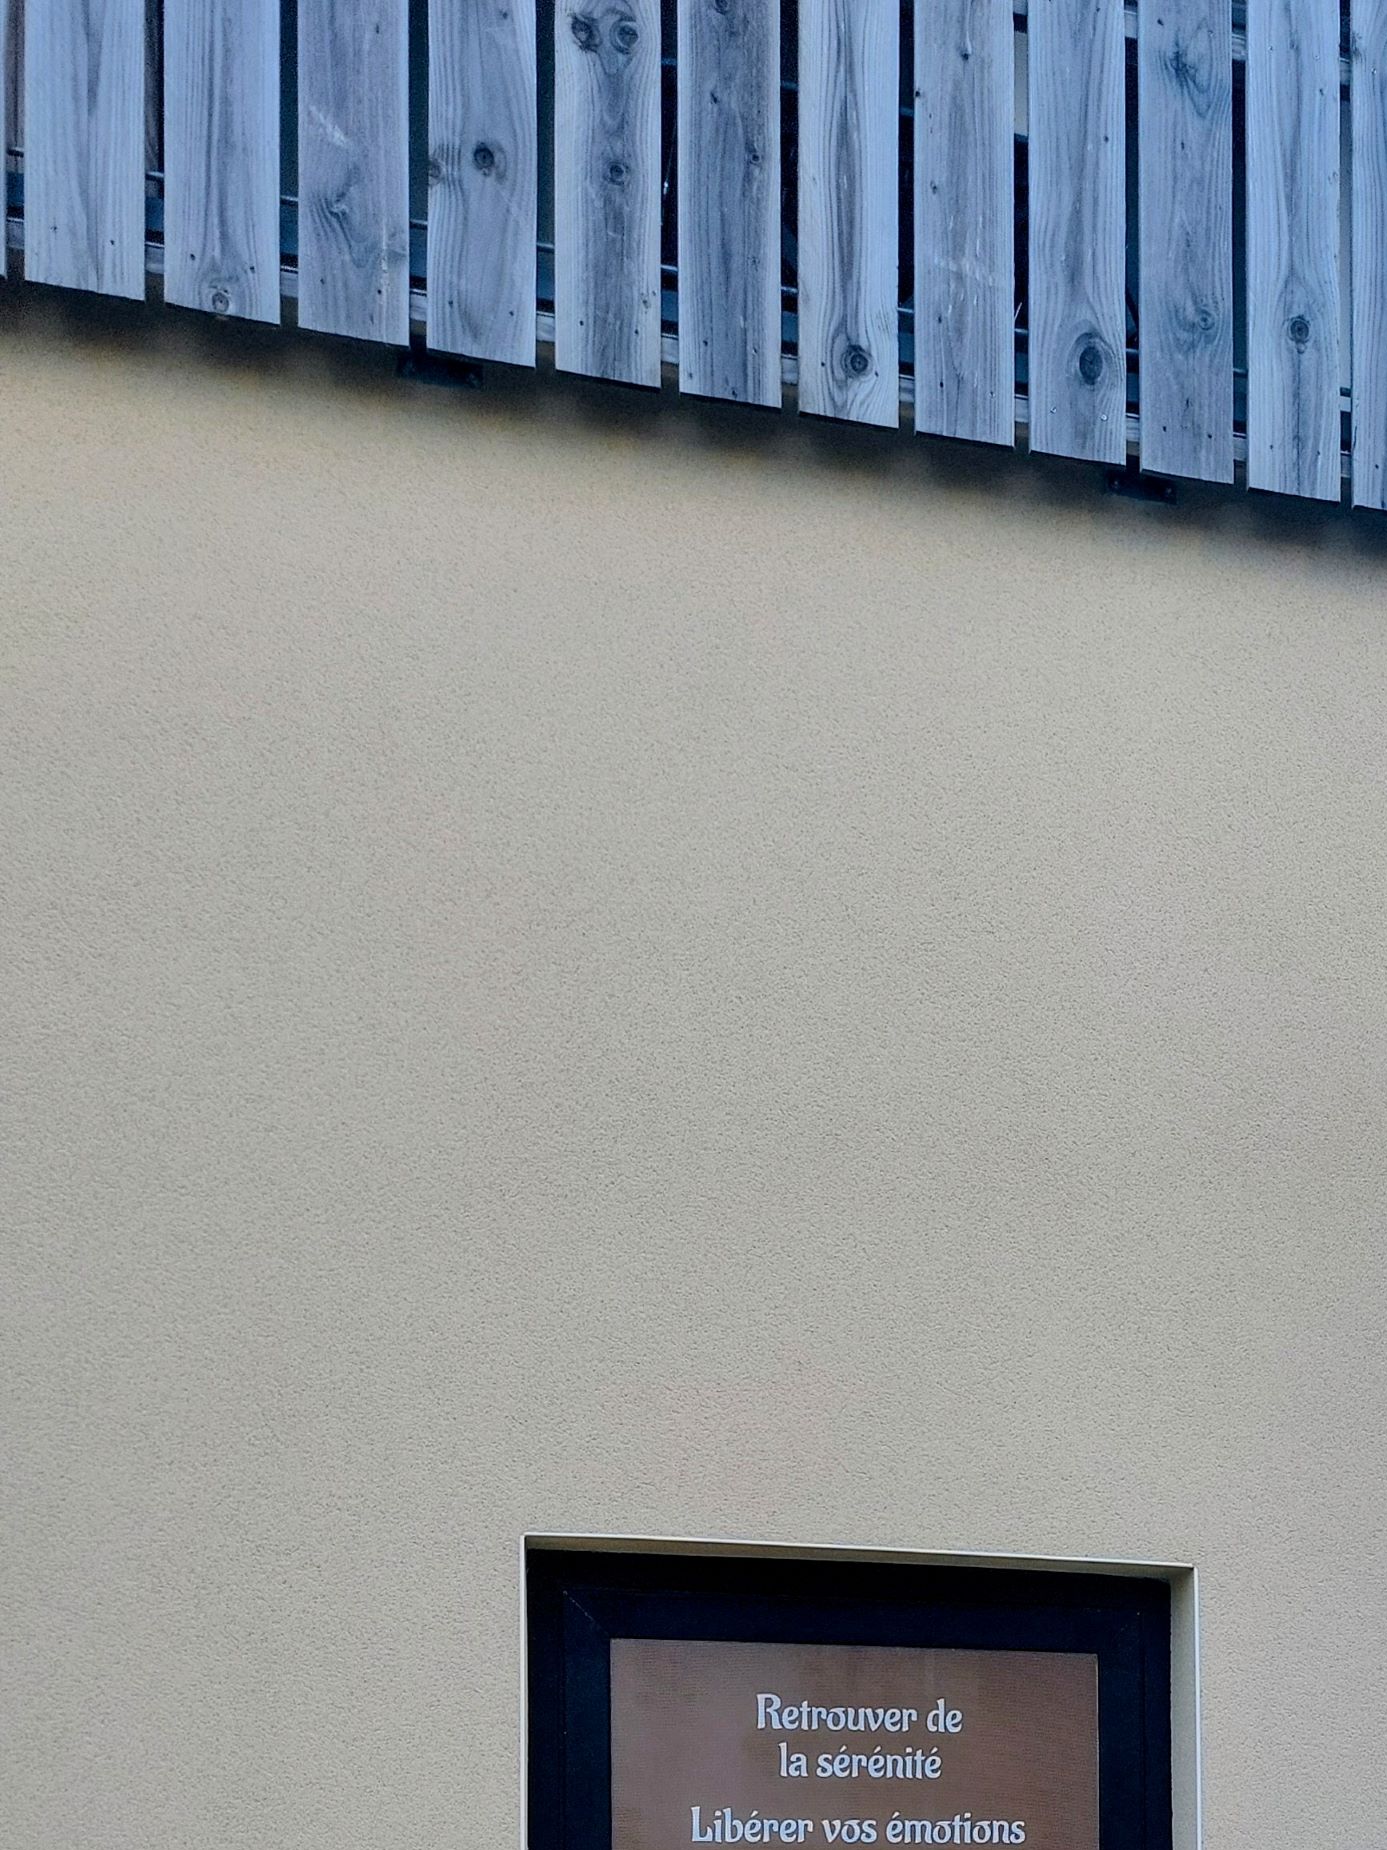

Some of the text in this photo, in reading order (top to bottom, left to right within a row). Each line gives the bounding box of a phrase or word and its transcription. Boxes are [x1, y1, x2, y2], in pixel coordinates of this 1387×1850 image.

[757, 1694, 962, 1732] Retrouver de
[779, 1742, 941, 1779] la sérénité
[691, 1806, 1025, 1844] Libérer vos émotions
